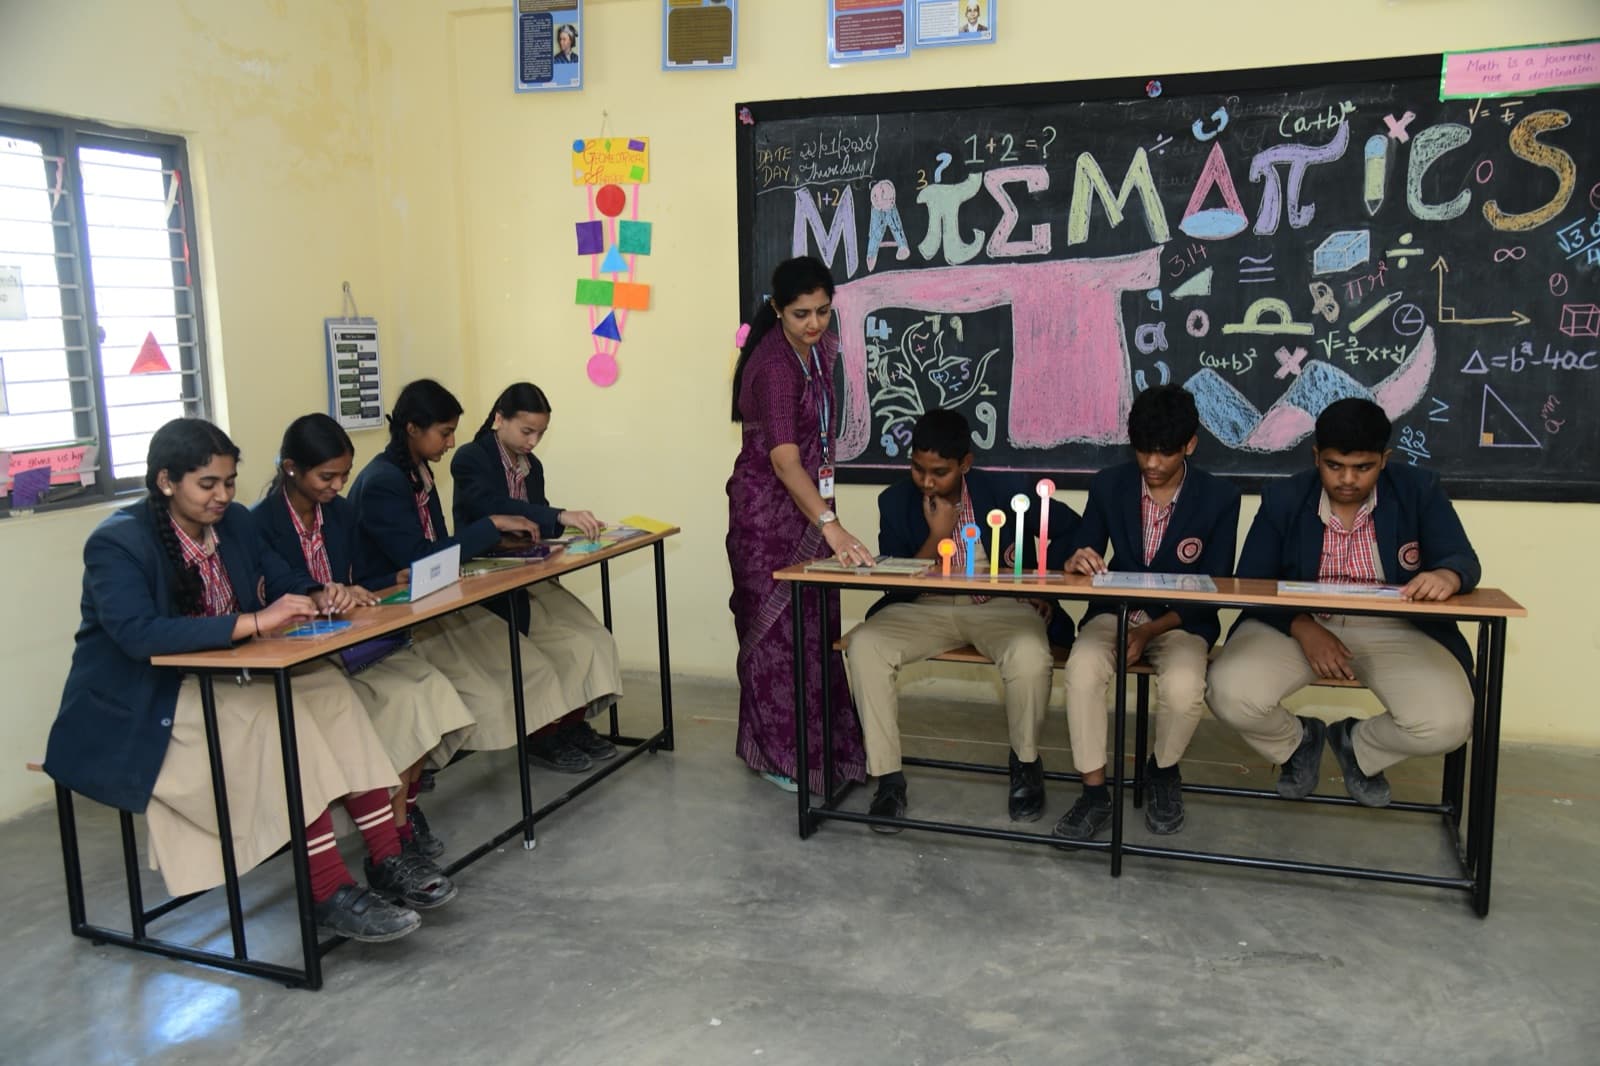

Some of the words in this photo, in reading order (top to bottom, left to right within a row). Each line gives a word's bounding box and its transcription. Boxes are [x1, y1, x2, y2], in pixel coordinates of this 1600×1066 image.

[1466, 58, 1499, 72] Math
[1525, 58, 1534, 66] a
[1511, 74, 1521, 82] a
[758, 146, 793, 170] DATE
